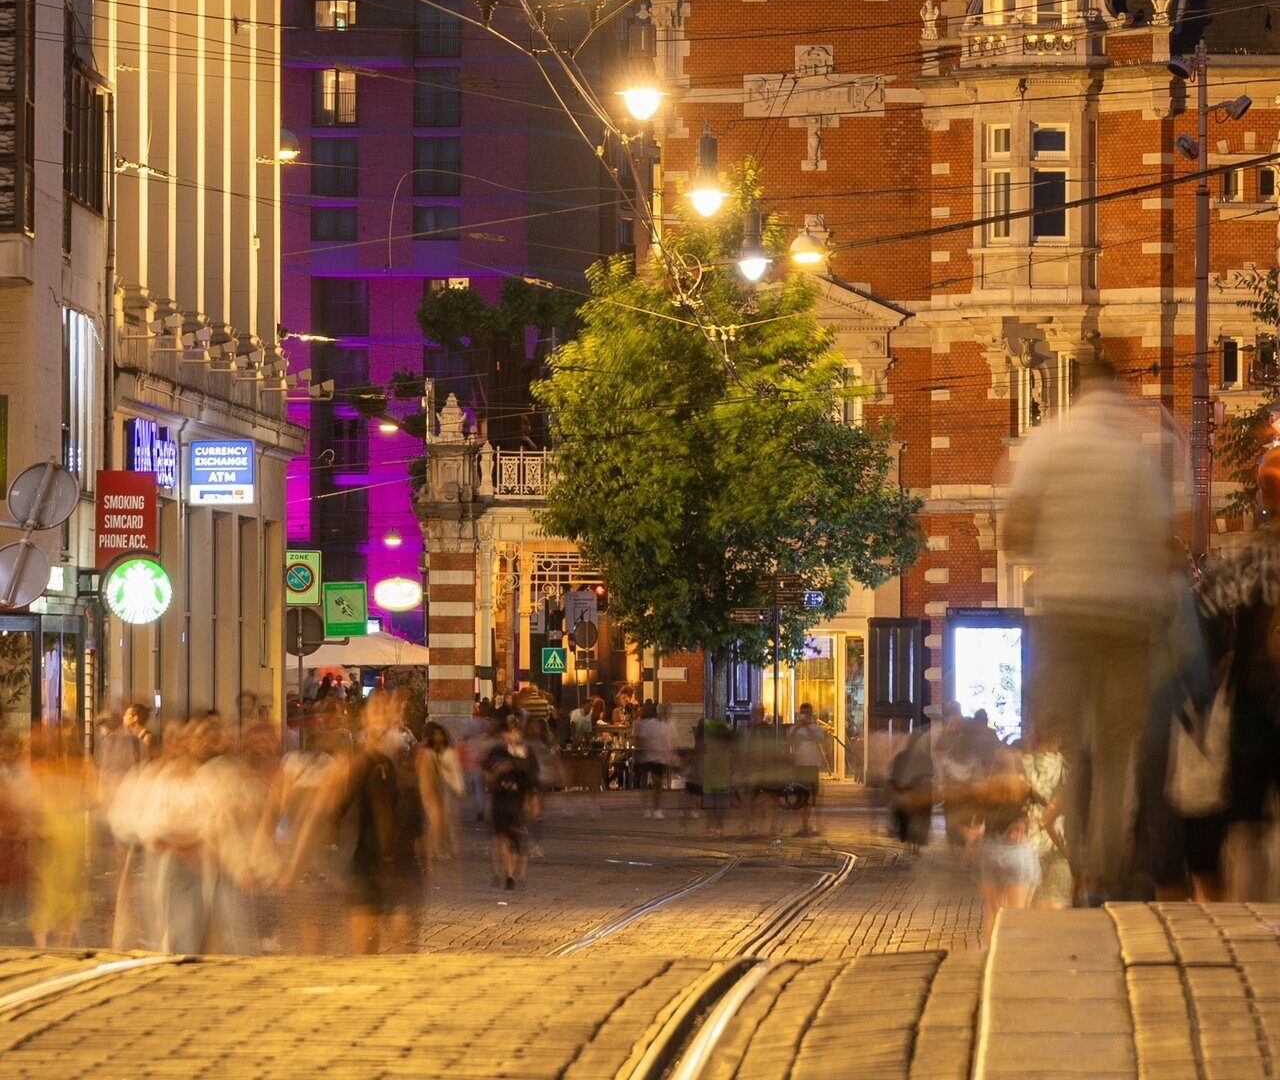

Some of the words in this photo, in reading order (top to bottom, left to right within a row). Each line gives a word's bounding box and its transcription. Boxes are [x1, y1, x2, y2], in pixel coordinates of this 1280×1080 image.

[194, 446, 249, 457] CURRENCY
[194, 457, 249, 467] EXCHANGE
[207, 471, 237, 484] ATM
[103, 494, 146, 511] SMOKING
[104, 514, 145, 530] SIMCARD
[98, 533, 128, 549] PHONE
[128, 533, 149, 549] ACC.
[289, 553, 310, 561] ZONE
